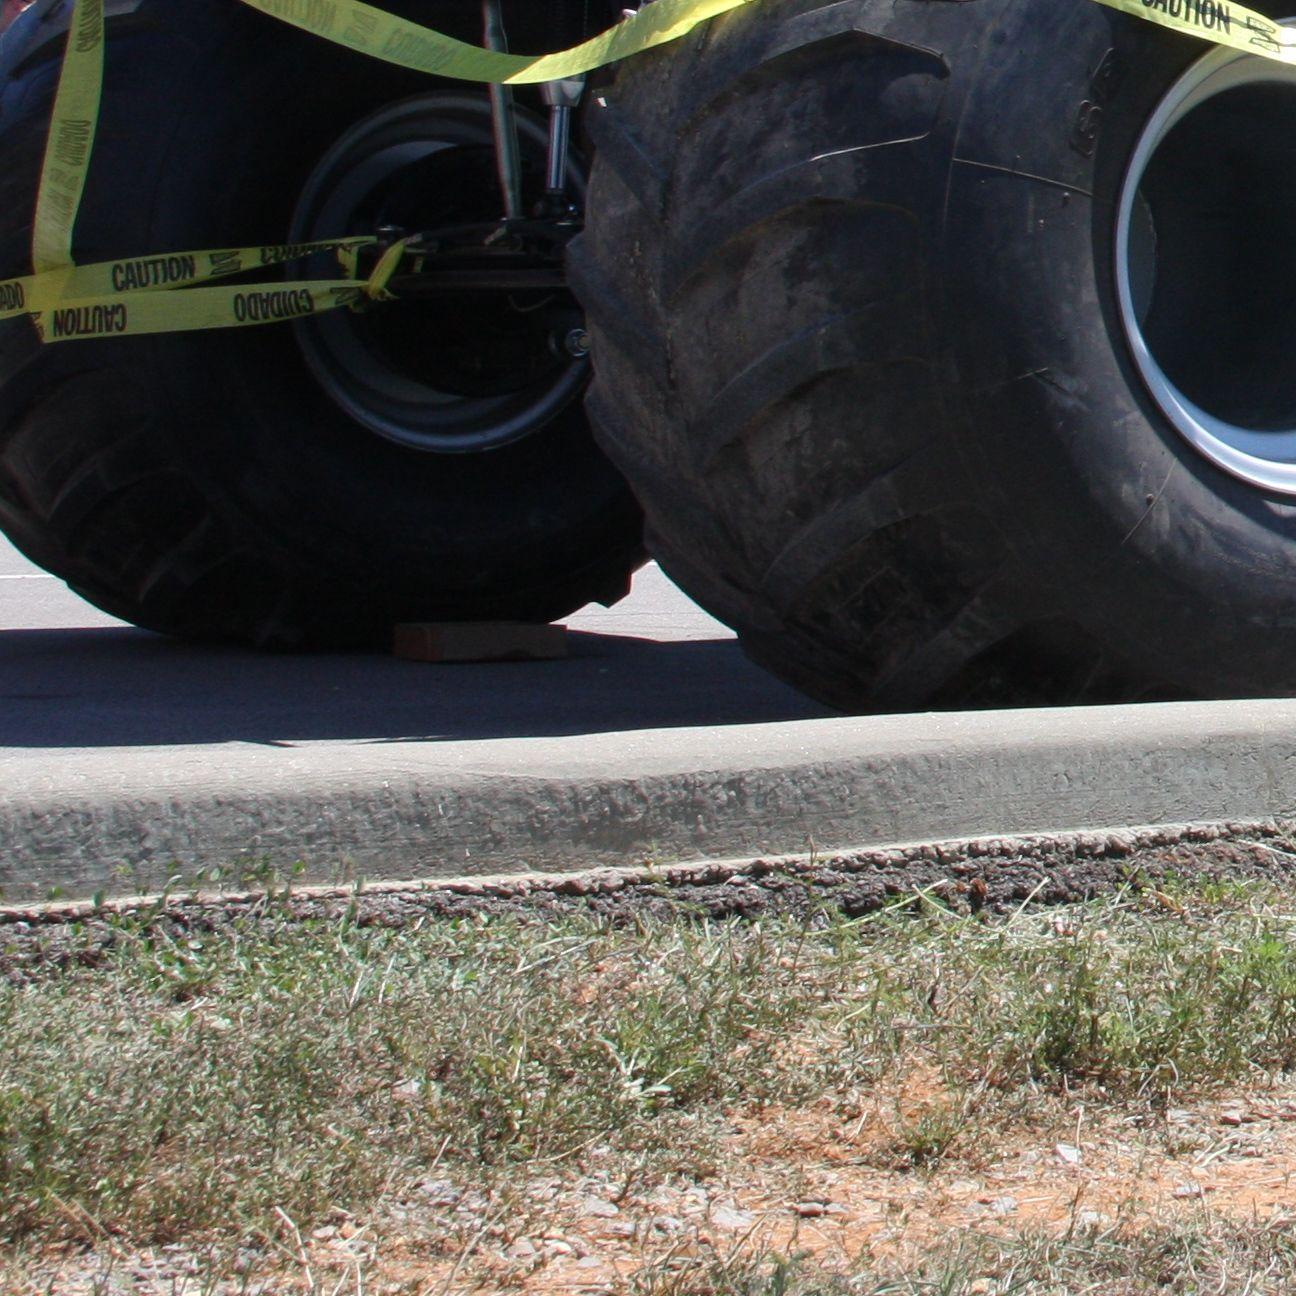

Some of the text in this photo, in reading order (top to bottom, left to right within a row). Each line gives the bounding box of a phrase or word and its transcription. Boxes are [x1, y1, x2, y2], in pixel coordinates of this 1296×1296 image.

[111, 254, 196, 293] CAUTION
[53, 288, 315, 338] CUIDADO CAUTION
